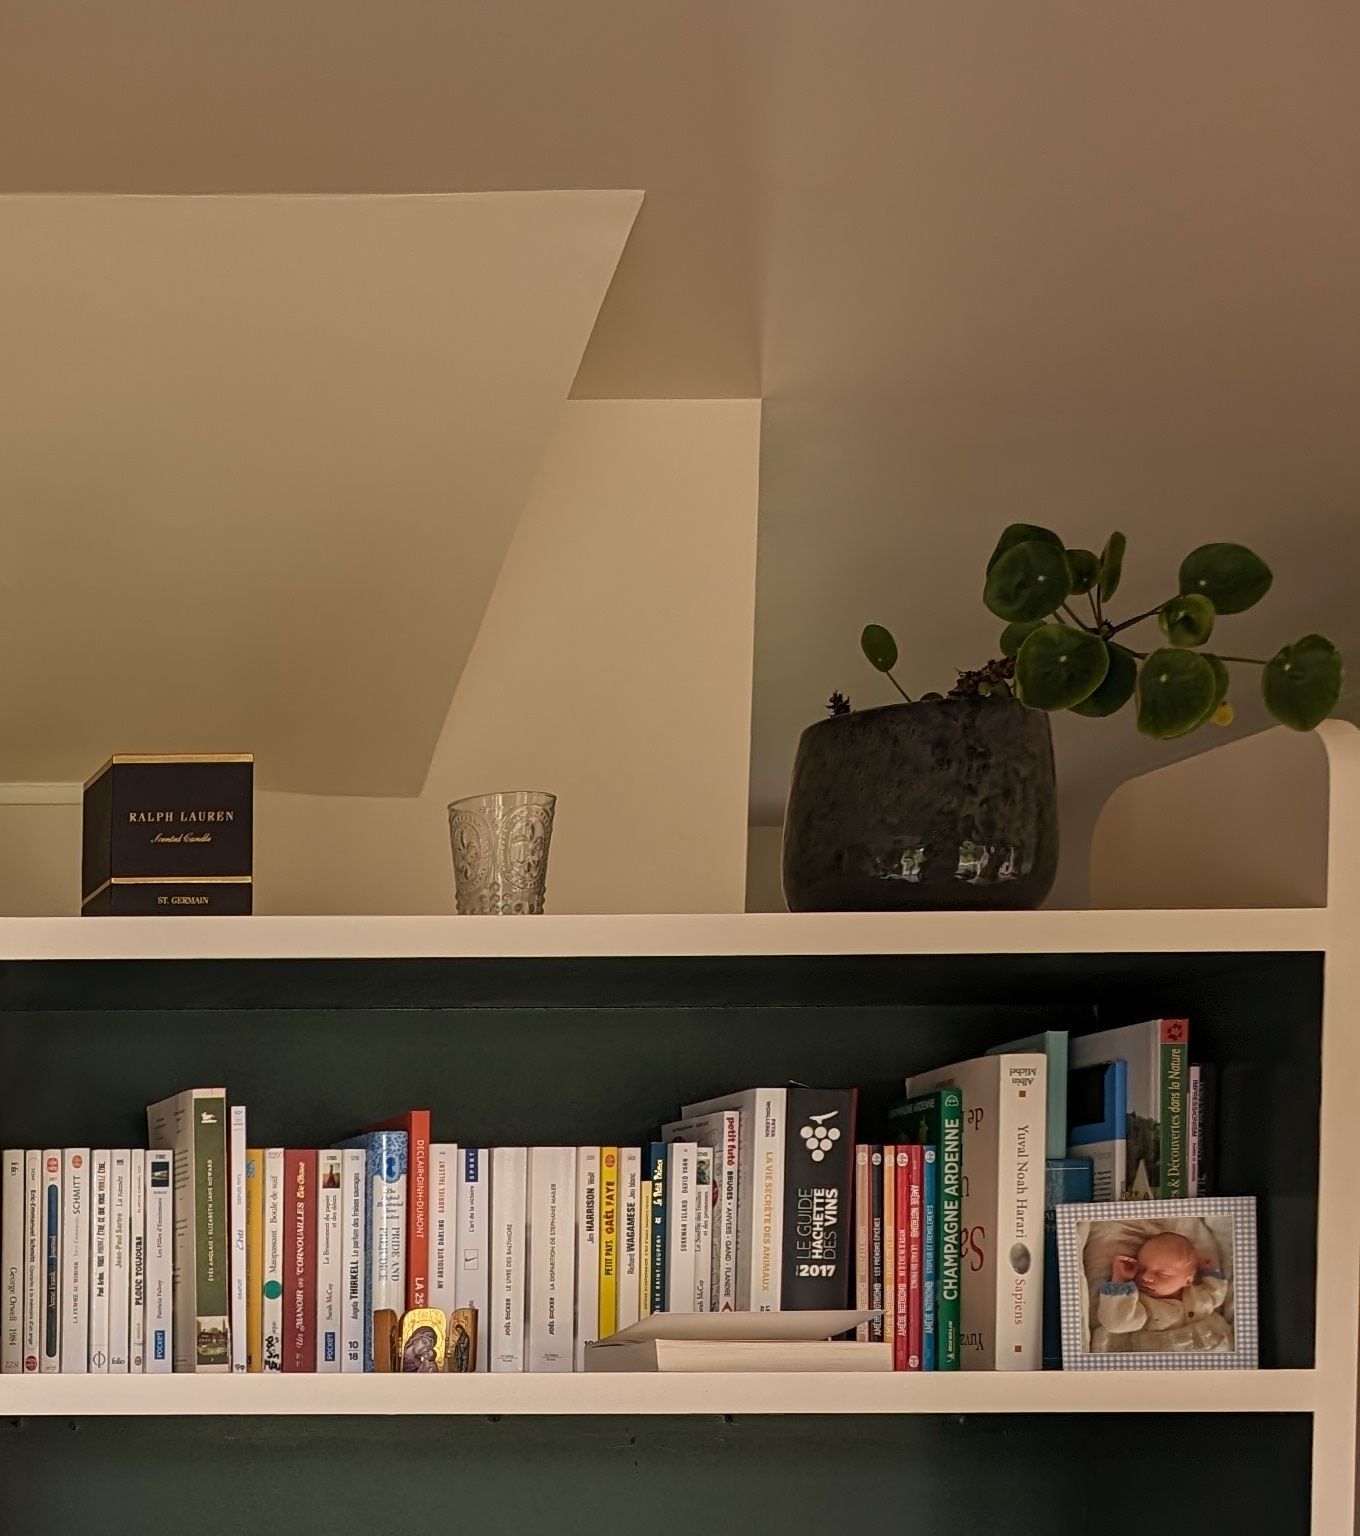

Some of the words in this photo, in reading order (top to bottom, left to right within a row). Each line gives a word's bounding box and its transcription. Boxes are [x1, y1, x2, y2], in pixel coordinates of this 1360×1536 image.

[129, 811, 174, 822] RALPH
[180, 810, 234, 821] LAUREN
[182, 832, 212, 843] Candle
[157, 896, 170, 904] ST.
[171, 896, 209, 904] GERMAIN
[1009, 1067, 1037, 1076] Michel
[1168, 1049, 1181, 1080] Nature
[1011, 1077, 1035, 1086] Albin
[1168, 1081, 1180, 1090] la
[1167, 1092, 1180, 1114] dans
[725, 1116, 739, 1142] petit
[1016, 1124, 1030, 1158] Yuval
[726, 1144, 737, 1167] futé
[765, 1151, 774, 1165] LA
[944, 1118, 960, 1197] ARDENNE
[1167, 1114, 1181, 1177] Découvertes
[726, 1170, 734, 1200] BRUGES
[765, 1166, 774, 1182] VIE
[1016, 1161, 1029, 1194] Noah
[1167, 1177, 1179, 1188] &
[72, 1175, 81, 1215] SCHMITT
[115, 1198, 123, 1207] La
[269, 1191, 279, 1204] de
[605, 1180, 614, 1207] FAYE
[628, 1189, 636, 1200] Jeu
[652, 1181, 663, 1198] Petit
[269, 1205, 279, 1224] Boule
[586, 1187, 595, 1232] HARRISON
[764, 1182, 775, 1225] SECRÈTE
[796, 1188, 813, 1238] GUIDE
[825, 1187, 838, 1227] VINS
[115, 1212, 123, 1234] Sartre
[603, 1208, 614, 1235] GAËL
[626, 1202, 635, 1253] WAGAMESE
[725, 1207, 733, 1236] ANVERS
[811, 1187, 826, 1260] HACHETTE
[1015, 1198, 1028, 1239] Harari
[295, 1202, 305, 1276] CORNOUAILLES
[391, 1226, 400, 1257] PRIDE
[437, 1219, 445, 1246] DARLING
[763, 1225, 772, 1245] DES
[823, 1231, 837, 1260] DES
[48, 1234, 57, 1258] Journal
[115, 1234, 123, 1269] Jean-Paul
[134, 1236, 143, 1277] TOUJOURS
[269, 1230, 279, 1274] Maupassant
[605, 1239, 614, 1256] PAYS
[724, 1240, 732, 1262] GAND
[796, 1239, 810, 1260] LE
[943, 1200, 960, 1301] CHAMPAGNE
[391, 1260, 400, 1282] AND
[604, 1257, 613, 1276] PETIT
[627, 1253, 635, 1275] Richard
[762, 1246, 771, 1292] ANIMAUX
[798, 1264, 836, 1277] 2017
[8, 1266, 18, 1294] George
[47, 1271, 56, 1290] Frank
[134, 1278, 143, 1306] PLOUC
[326, 1283, 334, 1303] McCoy
[350, 1260, 359, 1300] THIRKELL
[415, 1276, 424, 1290] LA
[723, 1267, 732, 1298] FLANDRE
[8, 1296, 18, 1322] Orwell
[47, 1290, 55, 1309] Anne
[295, 1290, 304, 1332] MANOIR
[1012, 1278, 1026, 1325] Sapiens
[9, 1327, 18, 1346] 1984
[326, 1332, 334, 1361] POCKET
[348, 1341, 359, 1349] 10
[348, 1353, 359, 1361] 18
